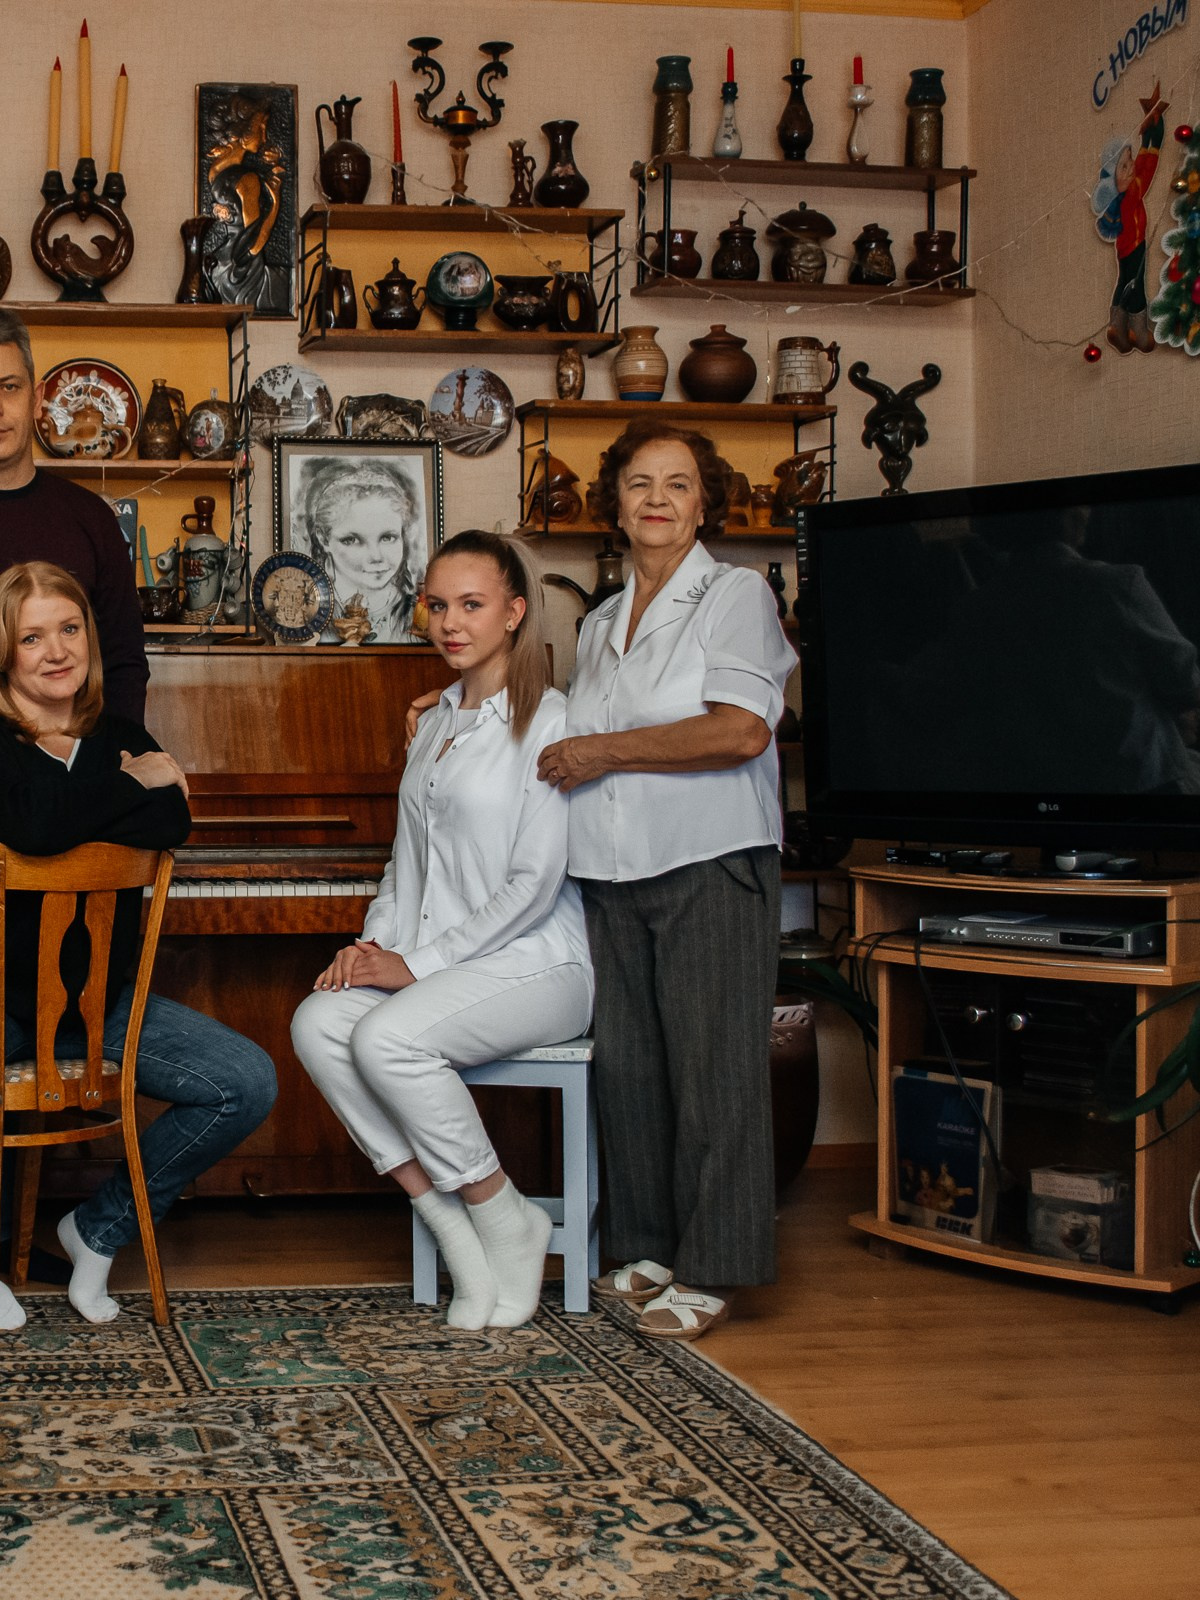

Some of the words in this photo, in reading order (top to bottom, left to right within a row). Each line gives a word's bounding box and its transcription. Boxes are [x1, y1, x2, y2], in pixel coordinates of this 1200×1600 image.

[1093, 71, 1108, 107] С
[1109, 0, 1188, 81] НОВЫМ
[937, 1121, 976, 1135] KARAOKE
[936, 1216, 973, 1235] BBK
